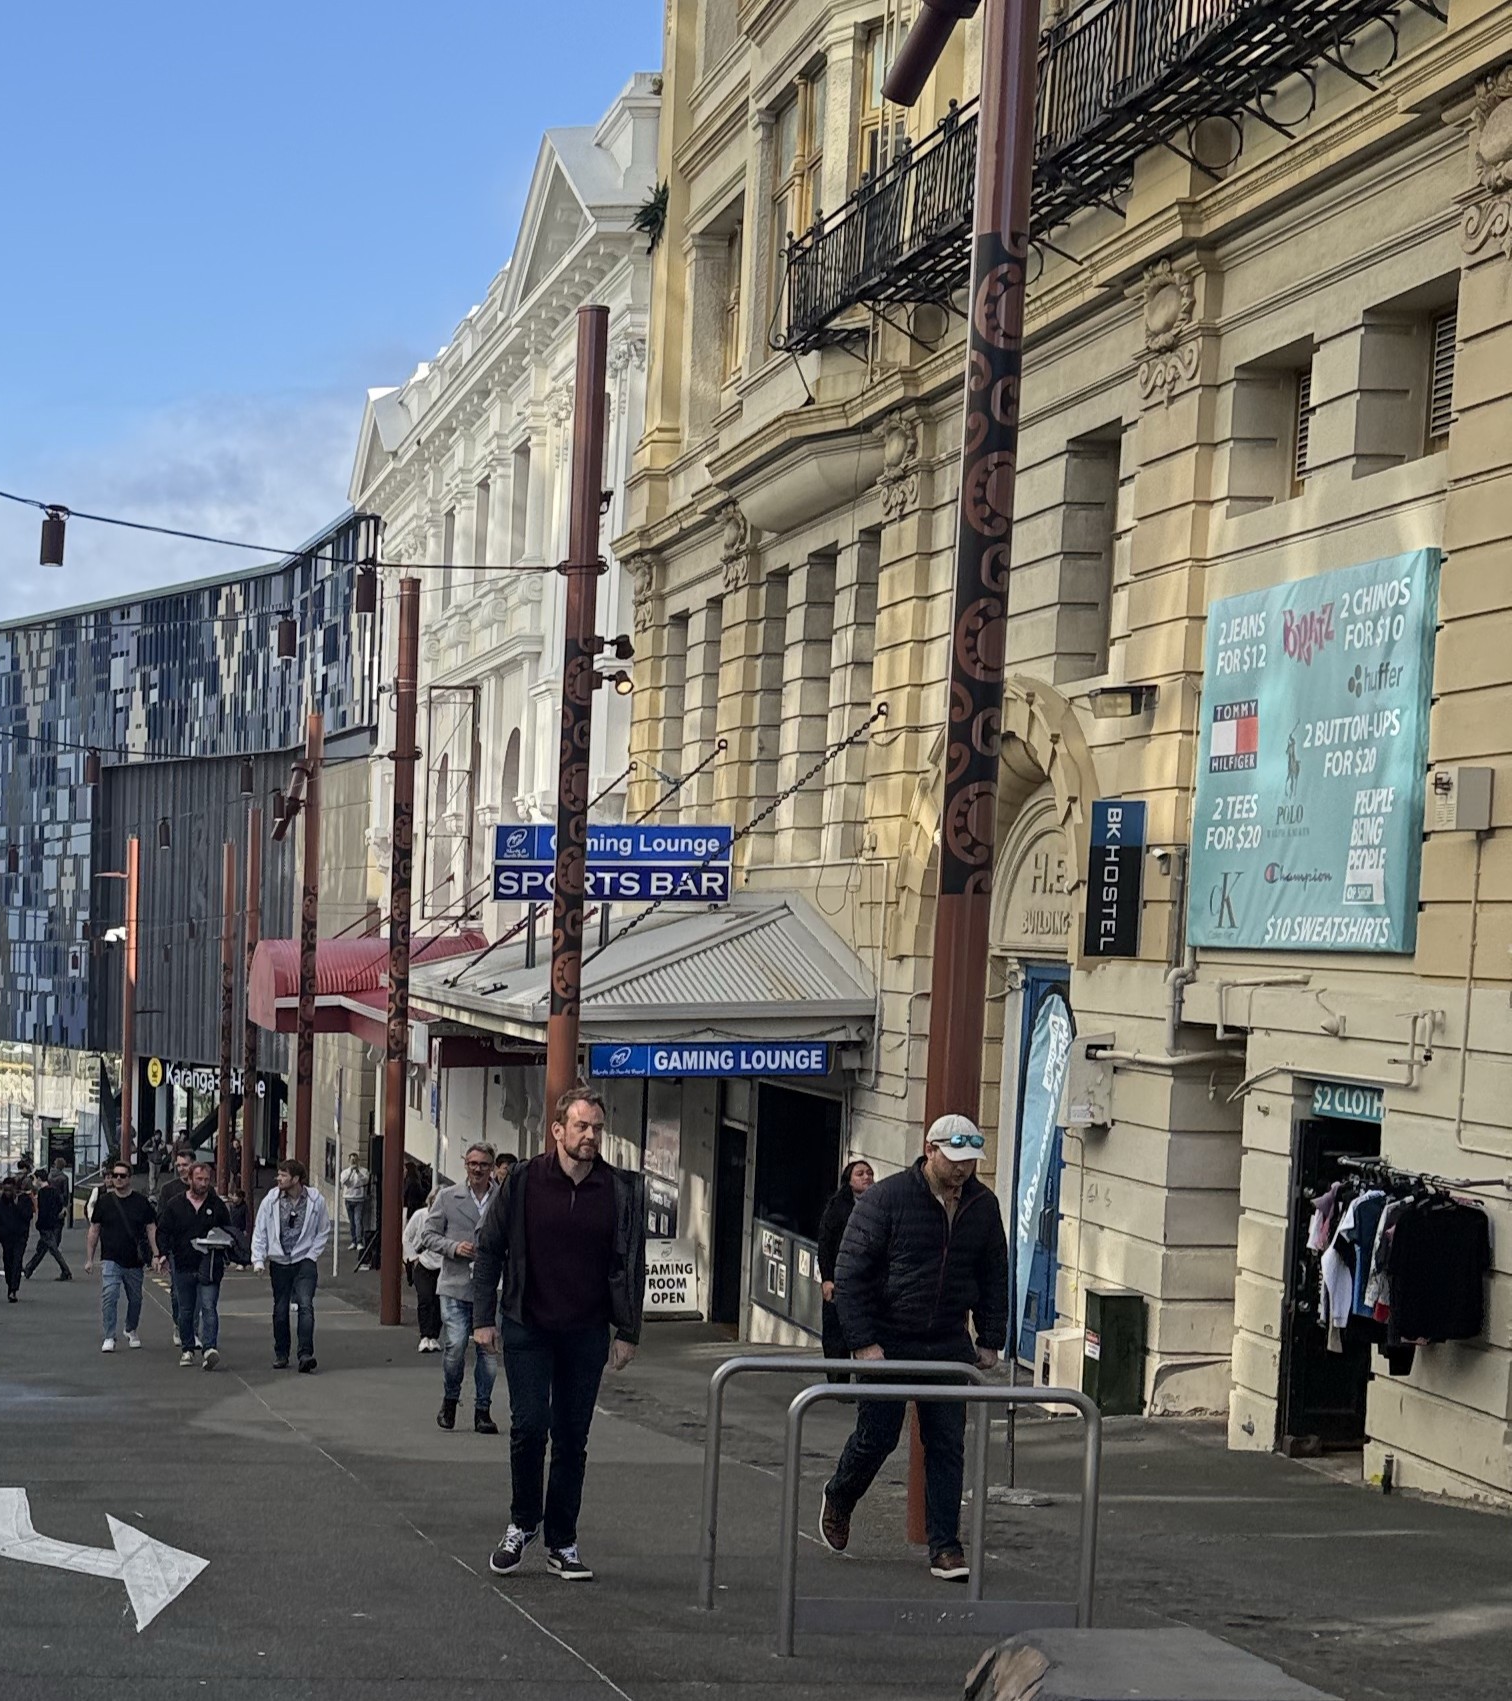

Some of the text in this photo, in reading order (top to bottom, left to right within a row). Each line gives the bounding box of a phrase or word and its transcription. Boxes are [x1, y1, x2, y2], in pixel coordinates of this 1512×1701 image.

[1340, 576, 1412, 619] 2 CHINOS
[1218, 611, 1267, 646] 2 JEANS
[1282, 601, 1336, 667] BRATZ
[1344, 614, 1405, 651] FOR $10
[1216, 643, 1267, 676] FOR $12
[1363, 661, 1403, 693] huffer
[1216, 701, 1257, 720] TOMMY
[1303, 708, 1401, 748] 2 BUTTON-UPS
[1211, 755, 1255, 772] HILFIGER
[1323, 747, 1377, 778] FOR $20
[1212, 793, 1259, 821] 2 TEES
[1276, 804, 1304, 825] POLO
[1354, 787, 1395, 815] PEOPLE
[639, 834, 720, 856] Lounge
[1205, 825, 1235, 851] FOR
[1236, 823, 1262, 851] $20
[1350, 816, 1384, 846] BEING
[1348, 847, 1387, 870] PEOPLE
[649, 871, 724, 896] BAR
[1099, 807, 1123, 952] BK HOSTEL
[1264, 861, 1332, 892] Champion
[1347, 886, 1357, 900] OP
[1264, 915, 1391, 944] $10 SWEATSHIRTS
[654, 1049, 822, 1071] GAMING LOUNGE
[1313, 1083, 1332, 1112] $2
[648, 1277, 687, 1290] ROOM
[651, 1292, 685, 1305] OPEN
